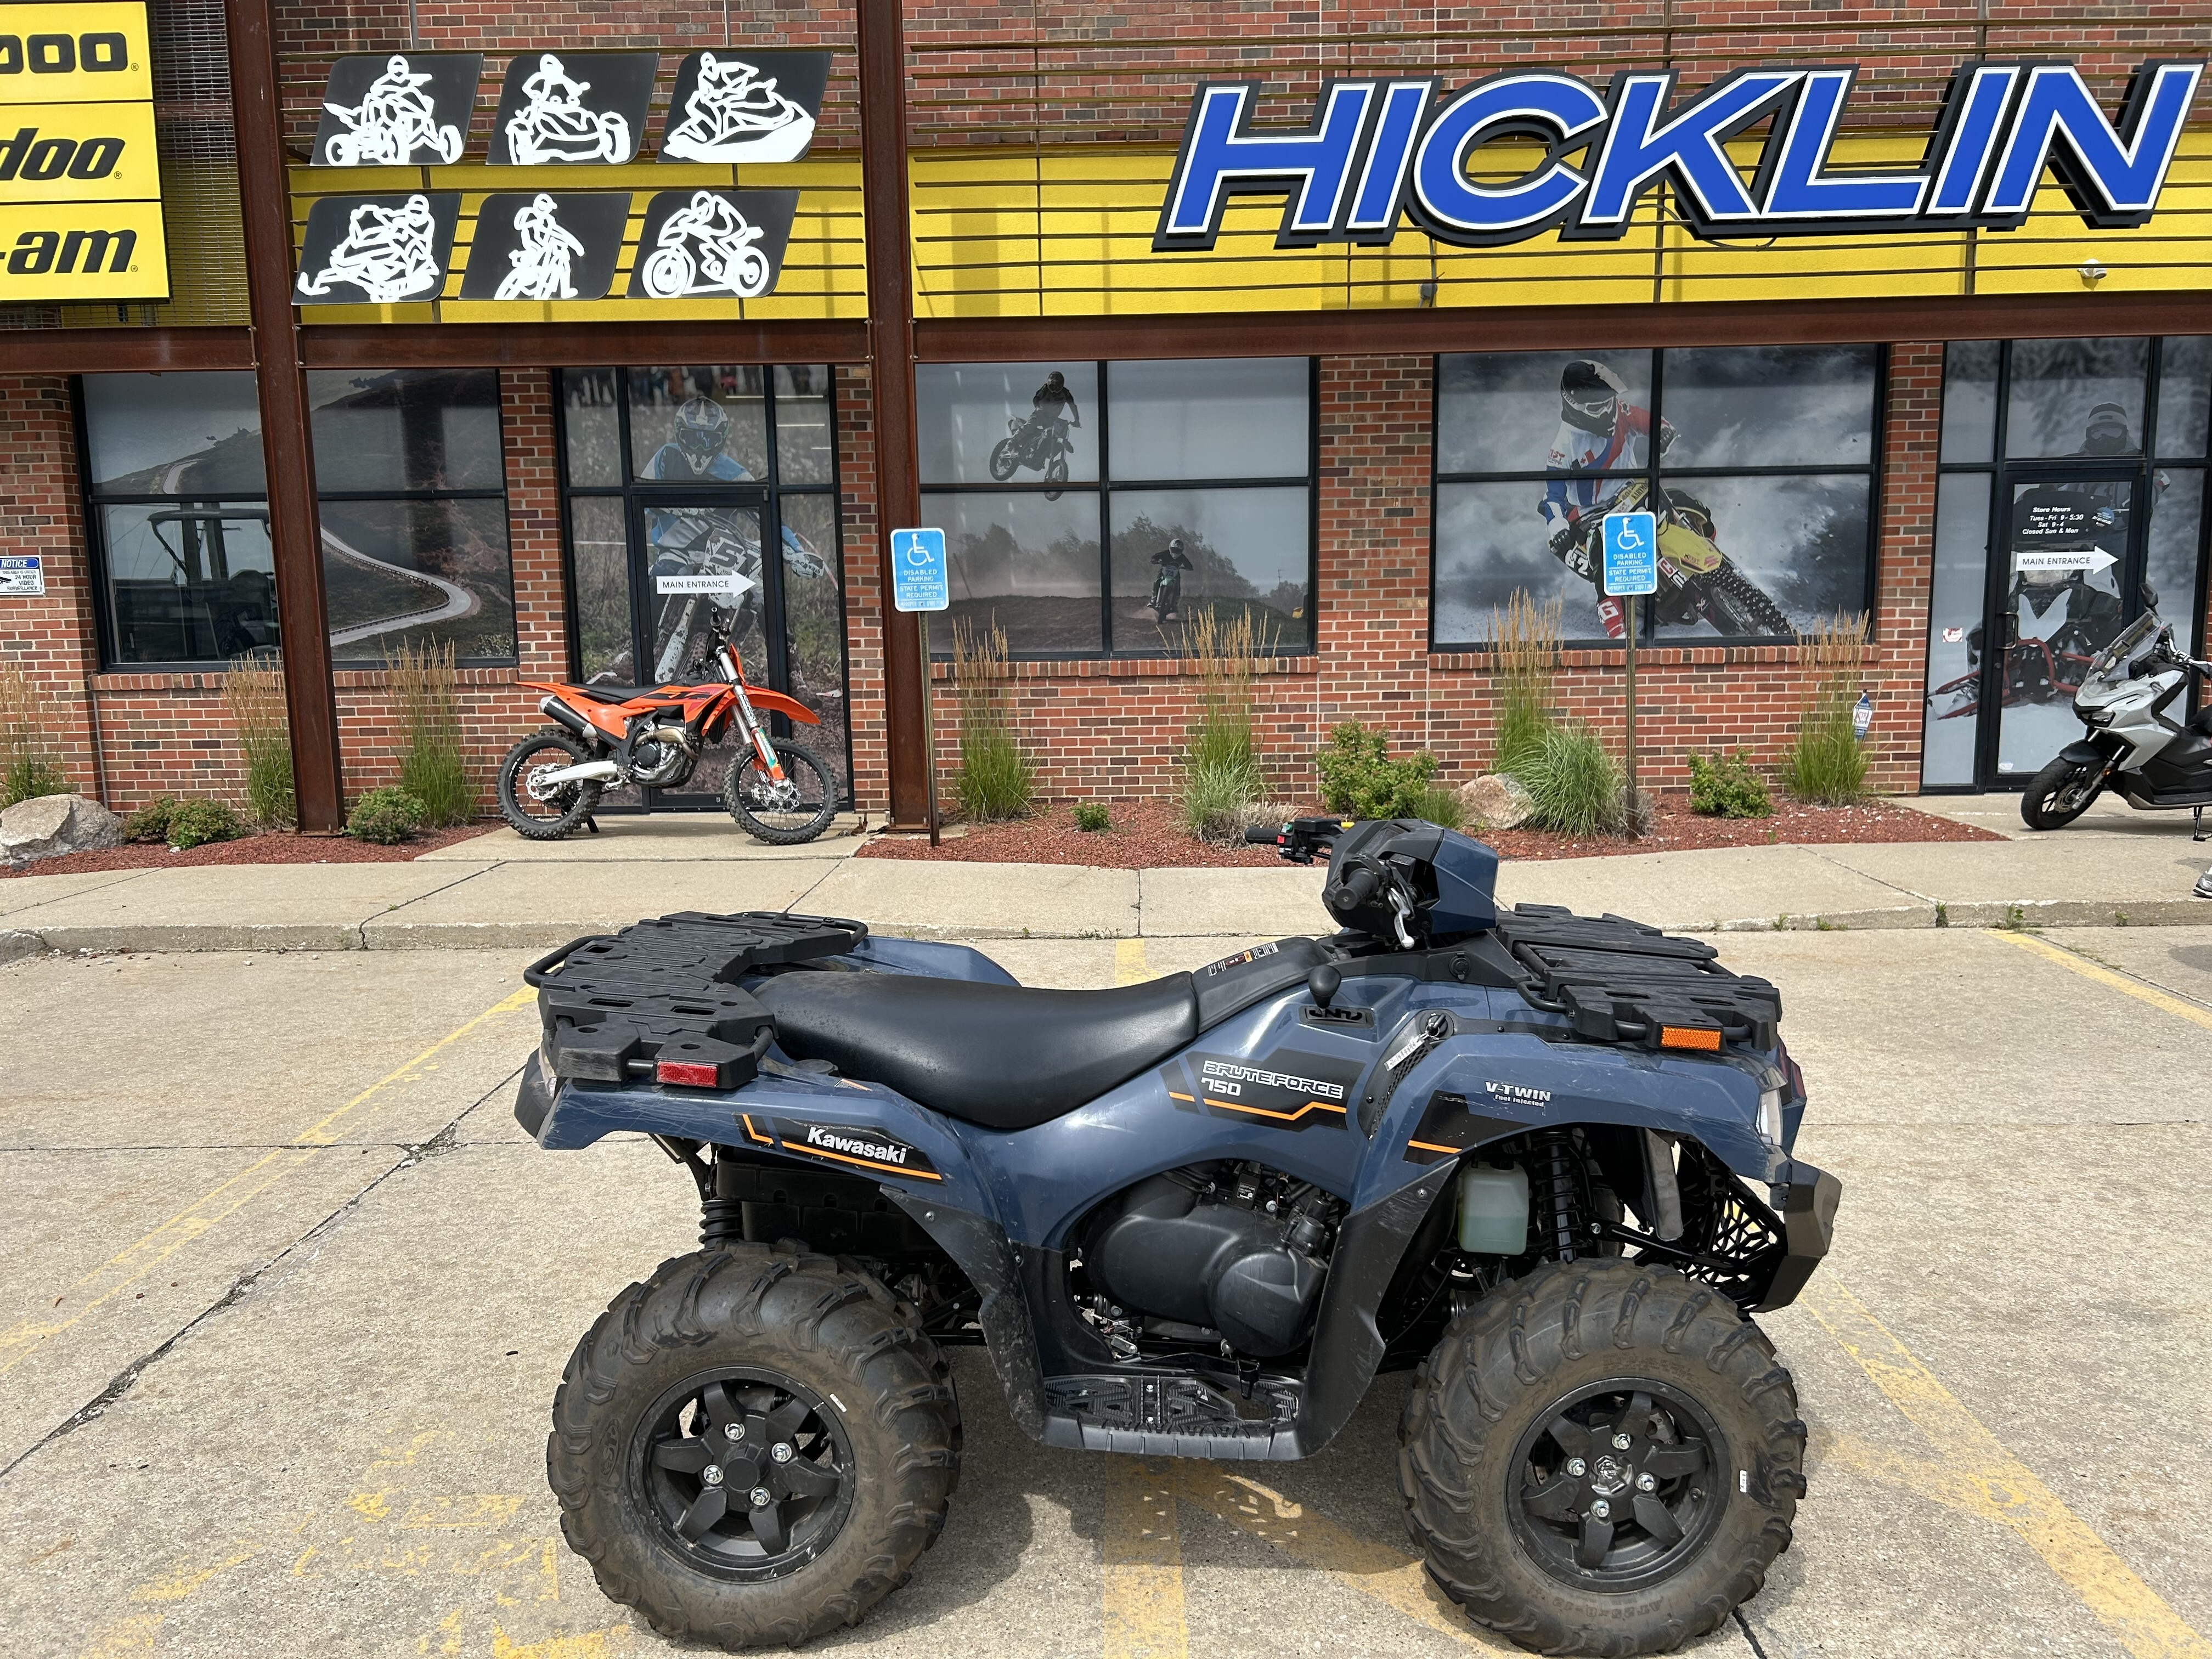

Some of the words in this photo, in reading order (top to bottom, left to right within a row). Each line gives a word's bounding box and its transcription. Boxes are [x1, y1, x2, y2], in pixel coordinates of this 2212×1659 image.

[1165, 63, 2202, 233] HICKLIN
[1201, 1077, 1242, 1096] 750
[1485, 1081, 1551, 1102] V-TWIN
[1513, 1097, 1544, 1107] Injected
[807, 1127, 907, 1164] Kawasaki
